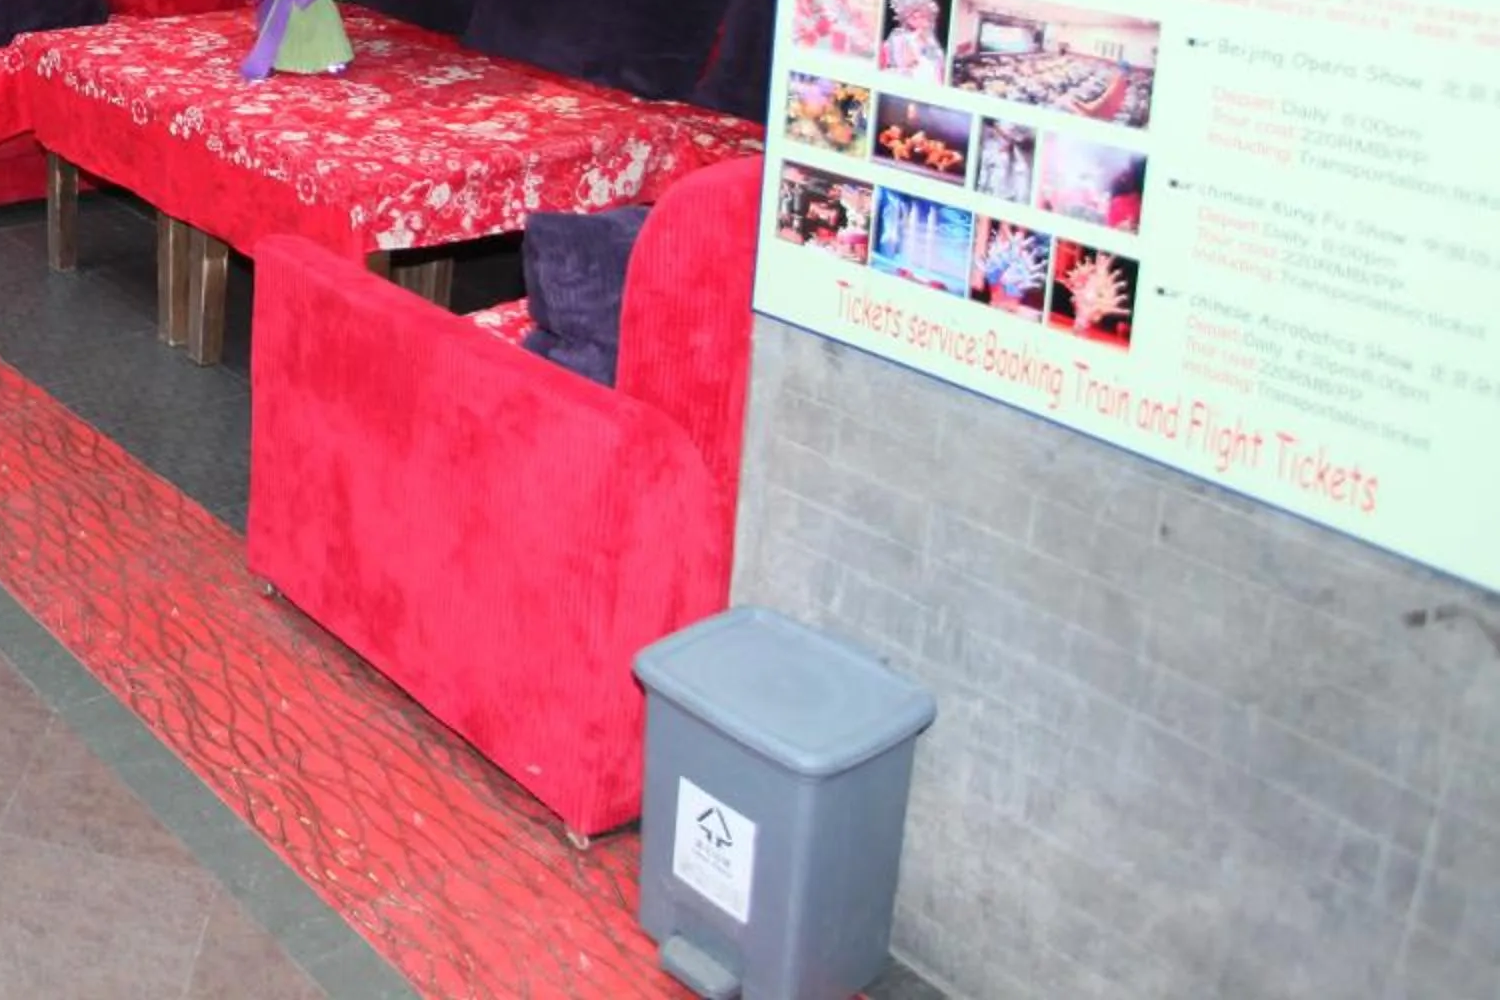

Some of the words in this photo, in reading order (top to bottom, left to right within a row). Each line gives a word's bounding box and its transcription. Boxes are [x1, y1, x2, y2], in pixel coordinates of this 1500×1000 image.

[836, 279, 904, 339] Tickets
[1073, 360, 1134, 419] Train
[1137, 384, 1179, 440] and
[1186, 400, 1264, 473] Flight
[1274, 430, 1381, 515] Tickets
